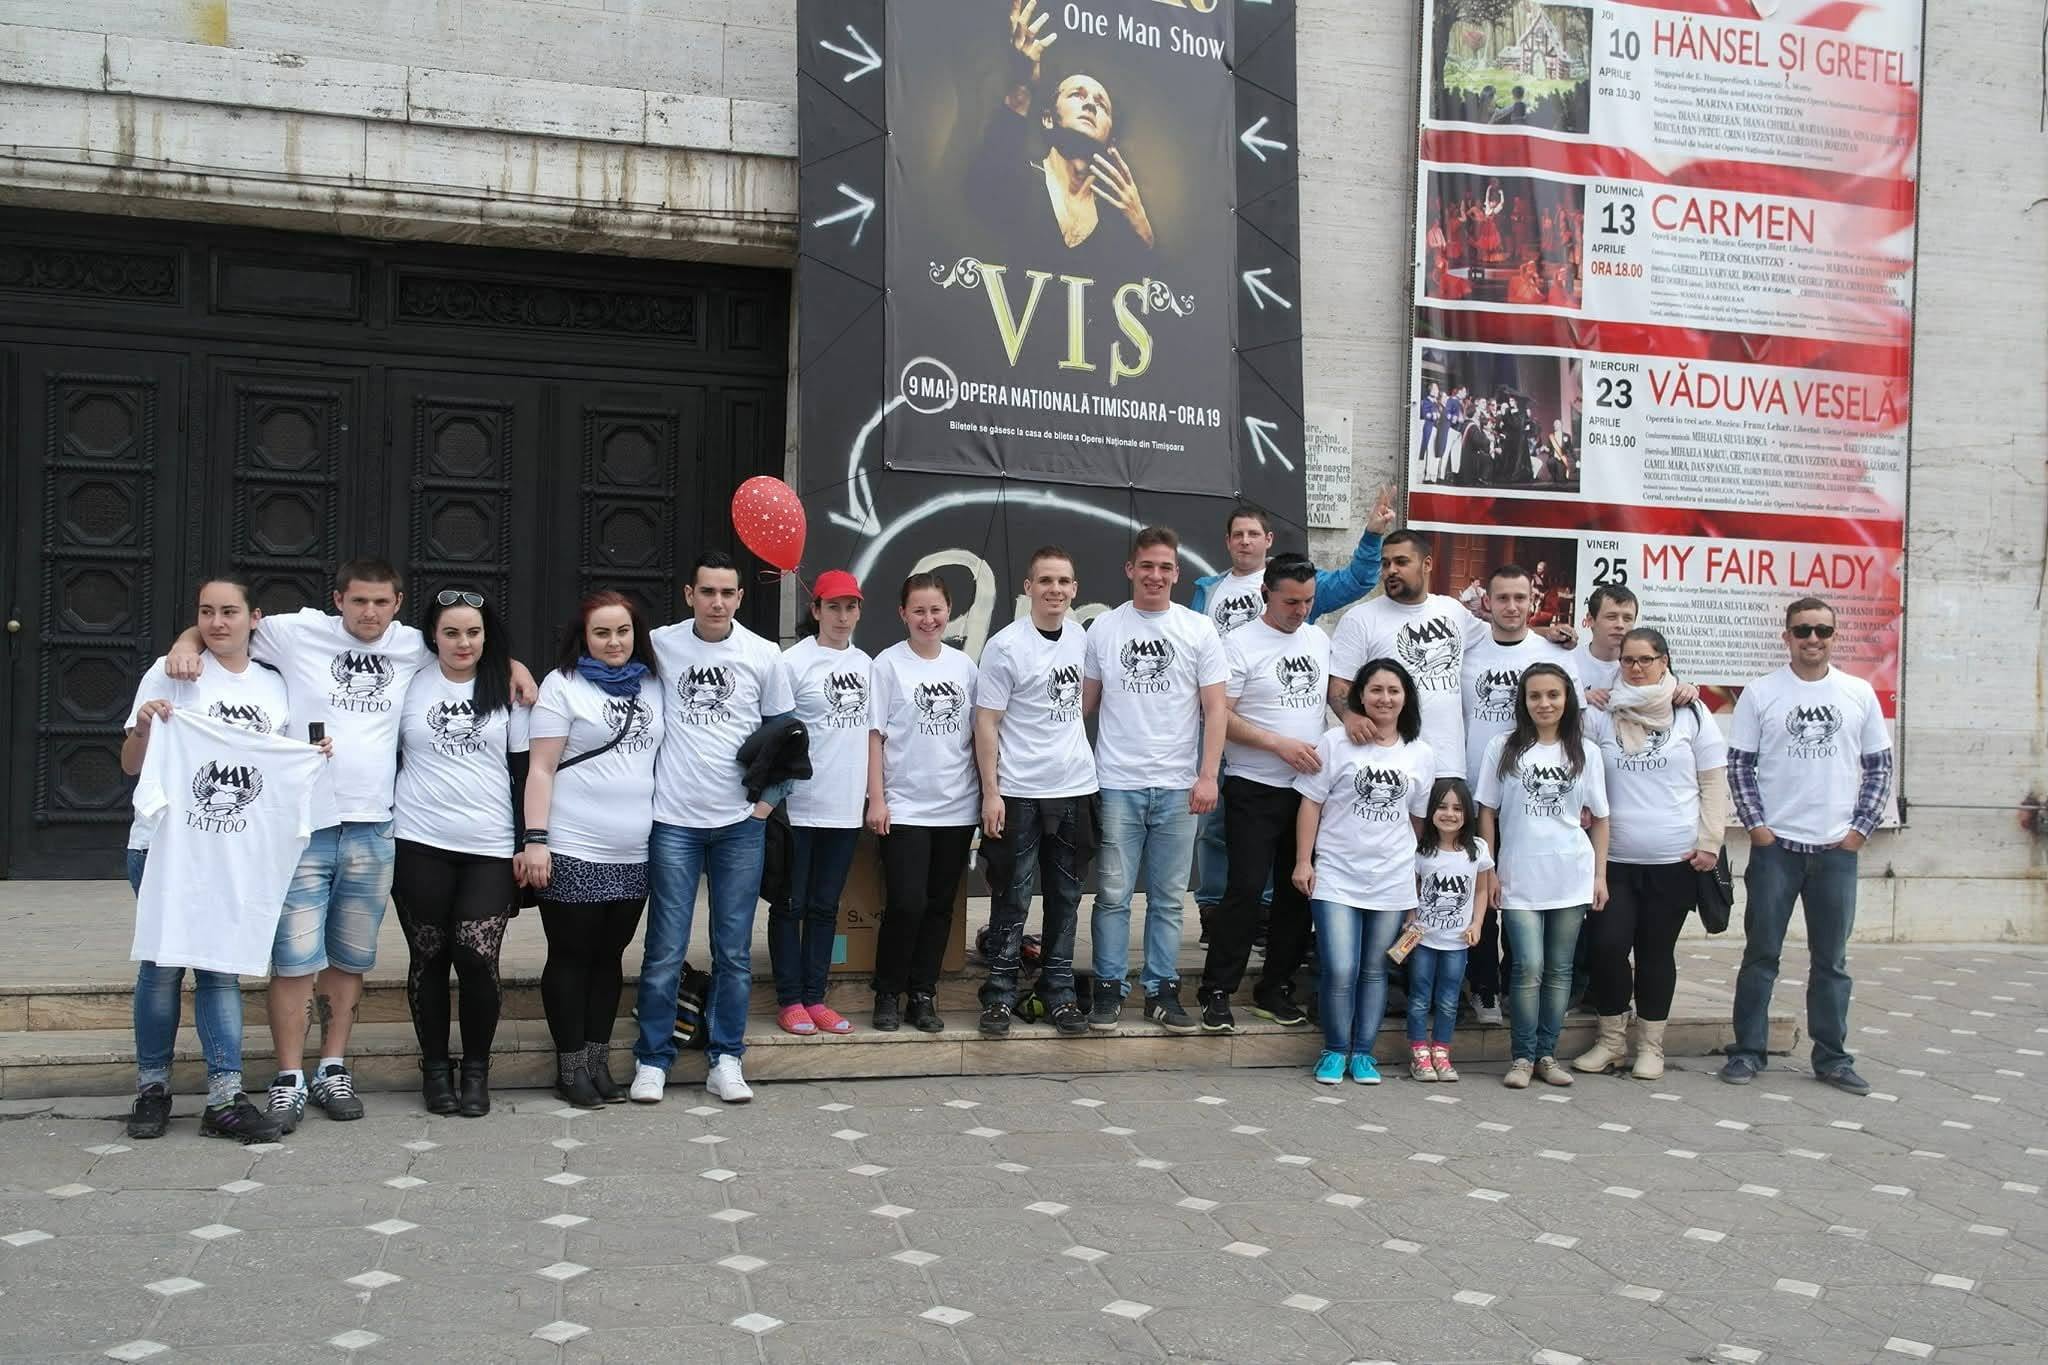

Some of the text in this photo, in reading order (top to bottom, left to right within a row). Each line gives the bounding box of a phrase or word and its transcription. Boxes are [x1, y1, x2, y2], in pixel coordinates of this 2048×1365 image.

[1601, 10, 1614, 20] JOI
[1064, 3, 1225, 60] One Man Show
[1609, 28, 1640, 61] 10
[1653, 17, 1769, 68] HÄNSEL
[1815, 40, 1913, 87] GRETEL
[1599, 66, 1631, 80] APRILIE
[1598, 87, 1614, 96] ora
[1696, 98, 1733, 110] MARINA
[1601, 202, 1635, 235] 13
[1651, 194, 1815, 244] CARMEN
[1591, 243, 1626, 254] APRILIE
[1700, 250, 1726, 263] PETER
[1591, 261, 1612, 275] ORA
[1615, 262, 1643, 278] 18.00
[977, 264, 1154, 386] VIS
[1589, 360, 1639, 373] MIERCURI
[908, 375, 918, 396] 9
[960, 381, 1008, 405] OPERA
[1092, 395, 1167, 422] TIMISOARA
[1177, 405, 1205, 427] ORA
[1206, 408, 1221, 427] 19
[1596, 377, 1633, 409] 23
[1648, 362, 1898, 424] VĂDUVA VESELĂ
[1589, 416, 1621, 427] APRILIE
[1743, 420, 1765, 430] Franz
[949, 420, 977, 432] Biletele
[979, 425, 988, 433] se
[1017, 427, 1024, 436] la
[1025, 430, 1042, 439] casa
[1043, 430, 1052, 439] de
[1054, 431, 1073, 441] bilete
[1081, 433, 1104, 445] Operei
[1139, 439, 1150, 449] din
[1589, 432, 1636, 448] ORA 19.00
[1692, 431, 1722, 444] MIHAELA
[1670, 446, 1701, 458] MIHAELA
[1730, 450, 1760, 461] CRISTIAN
[1587, 540, 1619, 551] VINERI
[1593, 557, 1628, 588] 25
[1641, 543, 1876, 591] MY FAIR LADY
[1223, 594, 1258, 611] MAX
[1691, 599, 1723, 611] MIHAELA
[1724, 600, 1746, 612] SILVIA
[1406, 616, 1455, 643] MAX
[1130, 637, 1168, 657] MAX
[342, 650, 386, 674] MAX
[1283, 656, 1314, 673] MAX
[688, 665, 728, 687] MAX
[831, 671, 864, 691] MAX
[1053, 664, 1080, 685] MAX
[1413, 673, 1459, 691] ATTO
[1485, 669, 1522, 687] MAX
[921, 680, 960, 697] MAX
[1120, 678, 1170, 694] TATTOO
[328, 692, 392, 713] TATTOO
[439, 700, 476, 716] MA
[1278, 694, 1322, 709] TATTOO
[219, 701, 264, 723] MAX
[678, 710, 731, 726] TATTOO
[1796, 704, 1835, 722] MAX
[429, 740, 488, 756] TATTOO
[1786, 744, 1838, 760] TATTOO
[1531, 764, 1570, 782] MAX
[1615, 756, 1667, 772] TATTOO
[207, 762, 258, 790] MAX
[1364, 766, 1402, 787] MAX
[185, 809, 247, 834] TATTOO
[1352, 803, 1400, 823] TATTOO
[1432, 872, 1470, 894] MAX
[1416, 909, 1464, 930] TATTOO
